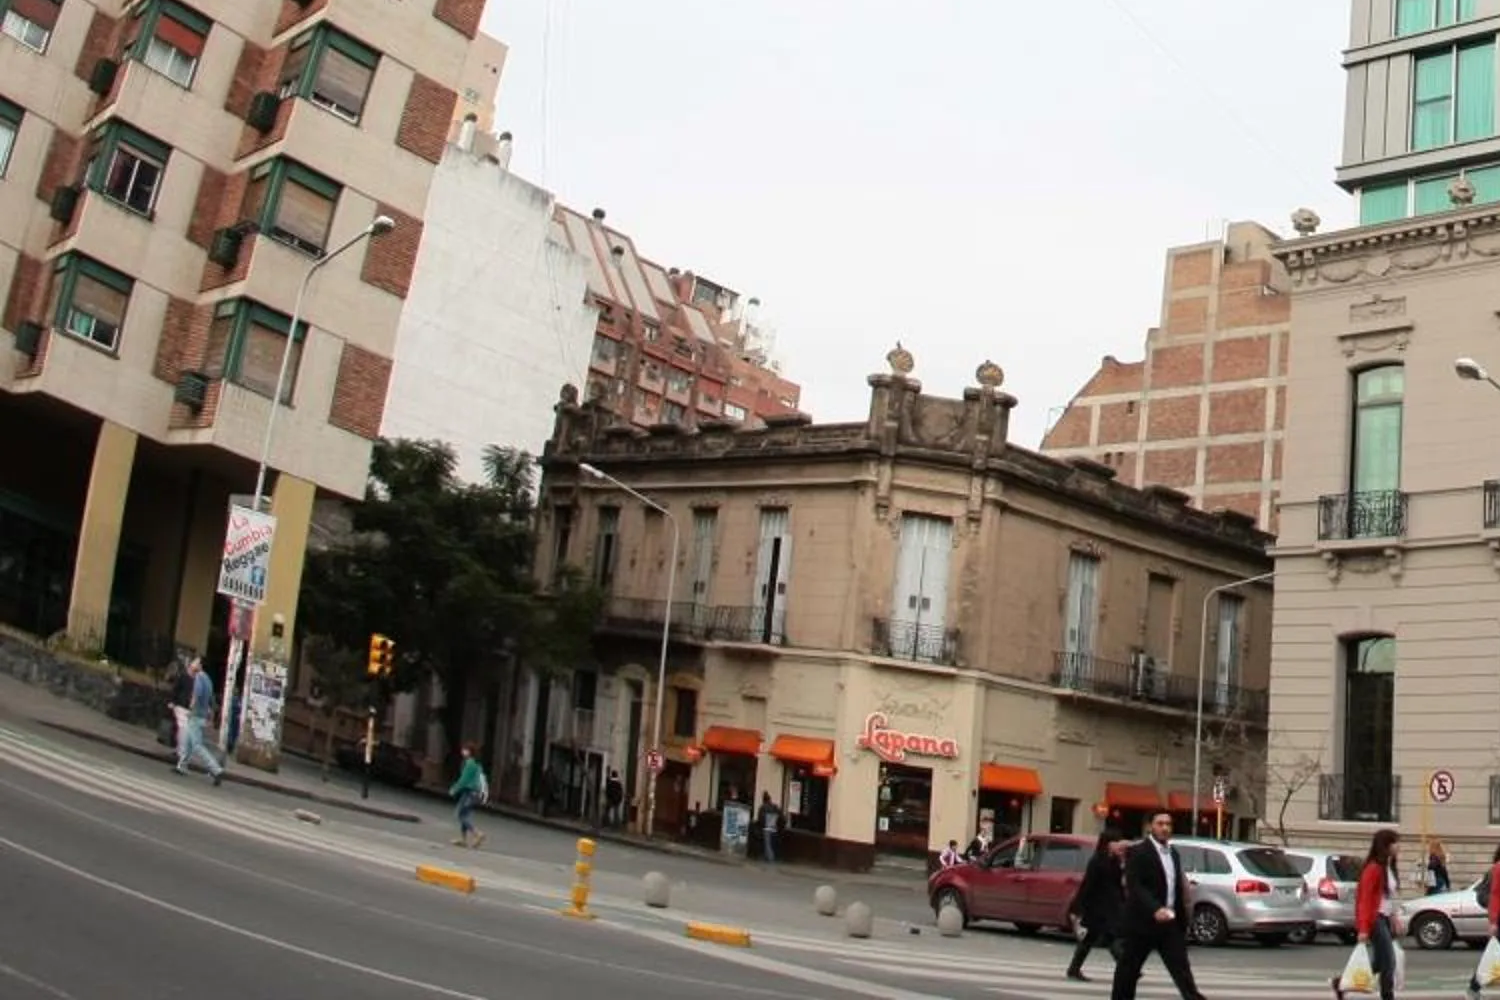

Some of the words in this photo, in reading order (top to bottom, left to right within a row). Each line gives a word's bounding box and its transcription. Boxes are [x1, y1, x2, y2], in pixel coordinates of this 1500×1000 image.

[231, 516, 250, 531] La
[224, 524, 273, 556] Cumbia
[224, 542, 270, 574] Reggae
[856, 711, 959, 761] Lapana
